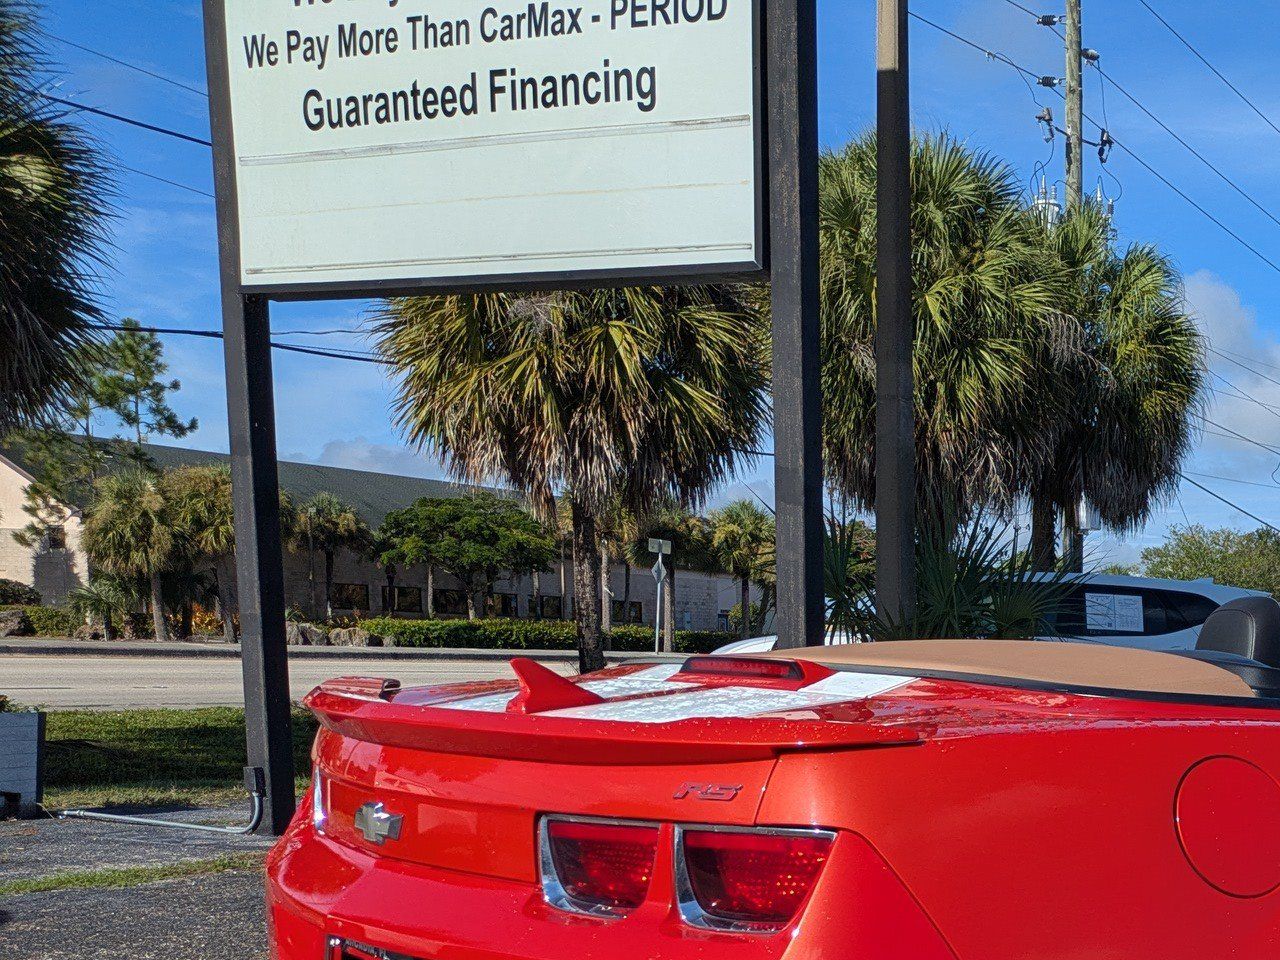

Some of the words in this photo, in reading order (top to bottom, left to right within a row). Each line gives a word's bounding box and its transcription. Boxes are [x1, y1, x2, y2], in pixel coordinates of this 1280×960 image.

[243, 33, 279, 69] We
[286, 30, 330, 71] Pay
[337, 22, 399, 59] More
[406, 14, 470, 51] Than
[480, 1, 583, 43] CarMax
[610, 0, 728, 30] PERIOD
[303, 72, 478, 132] Guaranteed
[489, 58, 657, 113] Financing
[673, 782, 743, 801] RS
